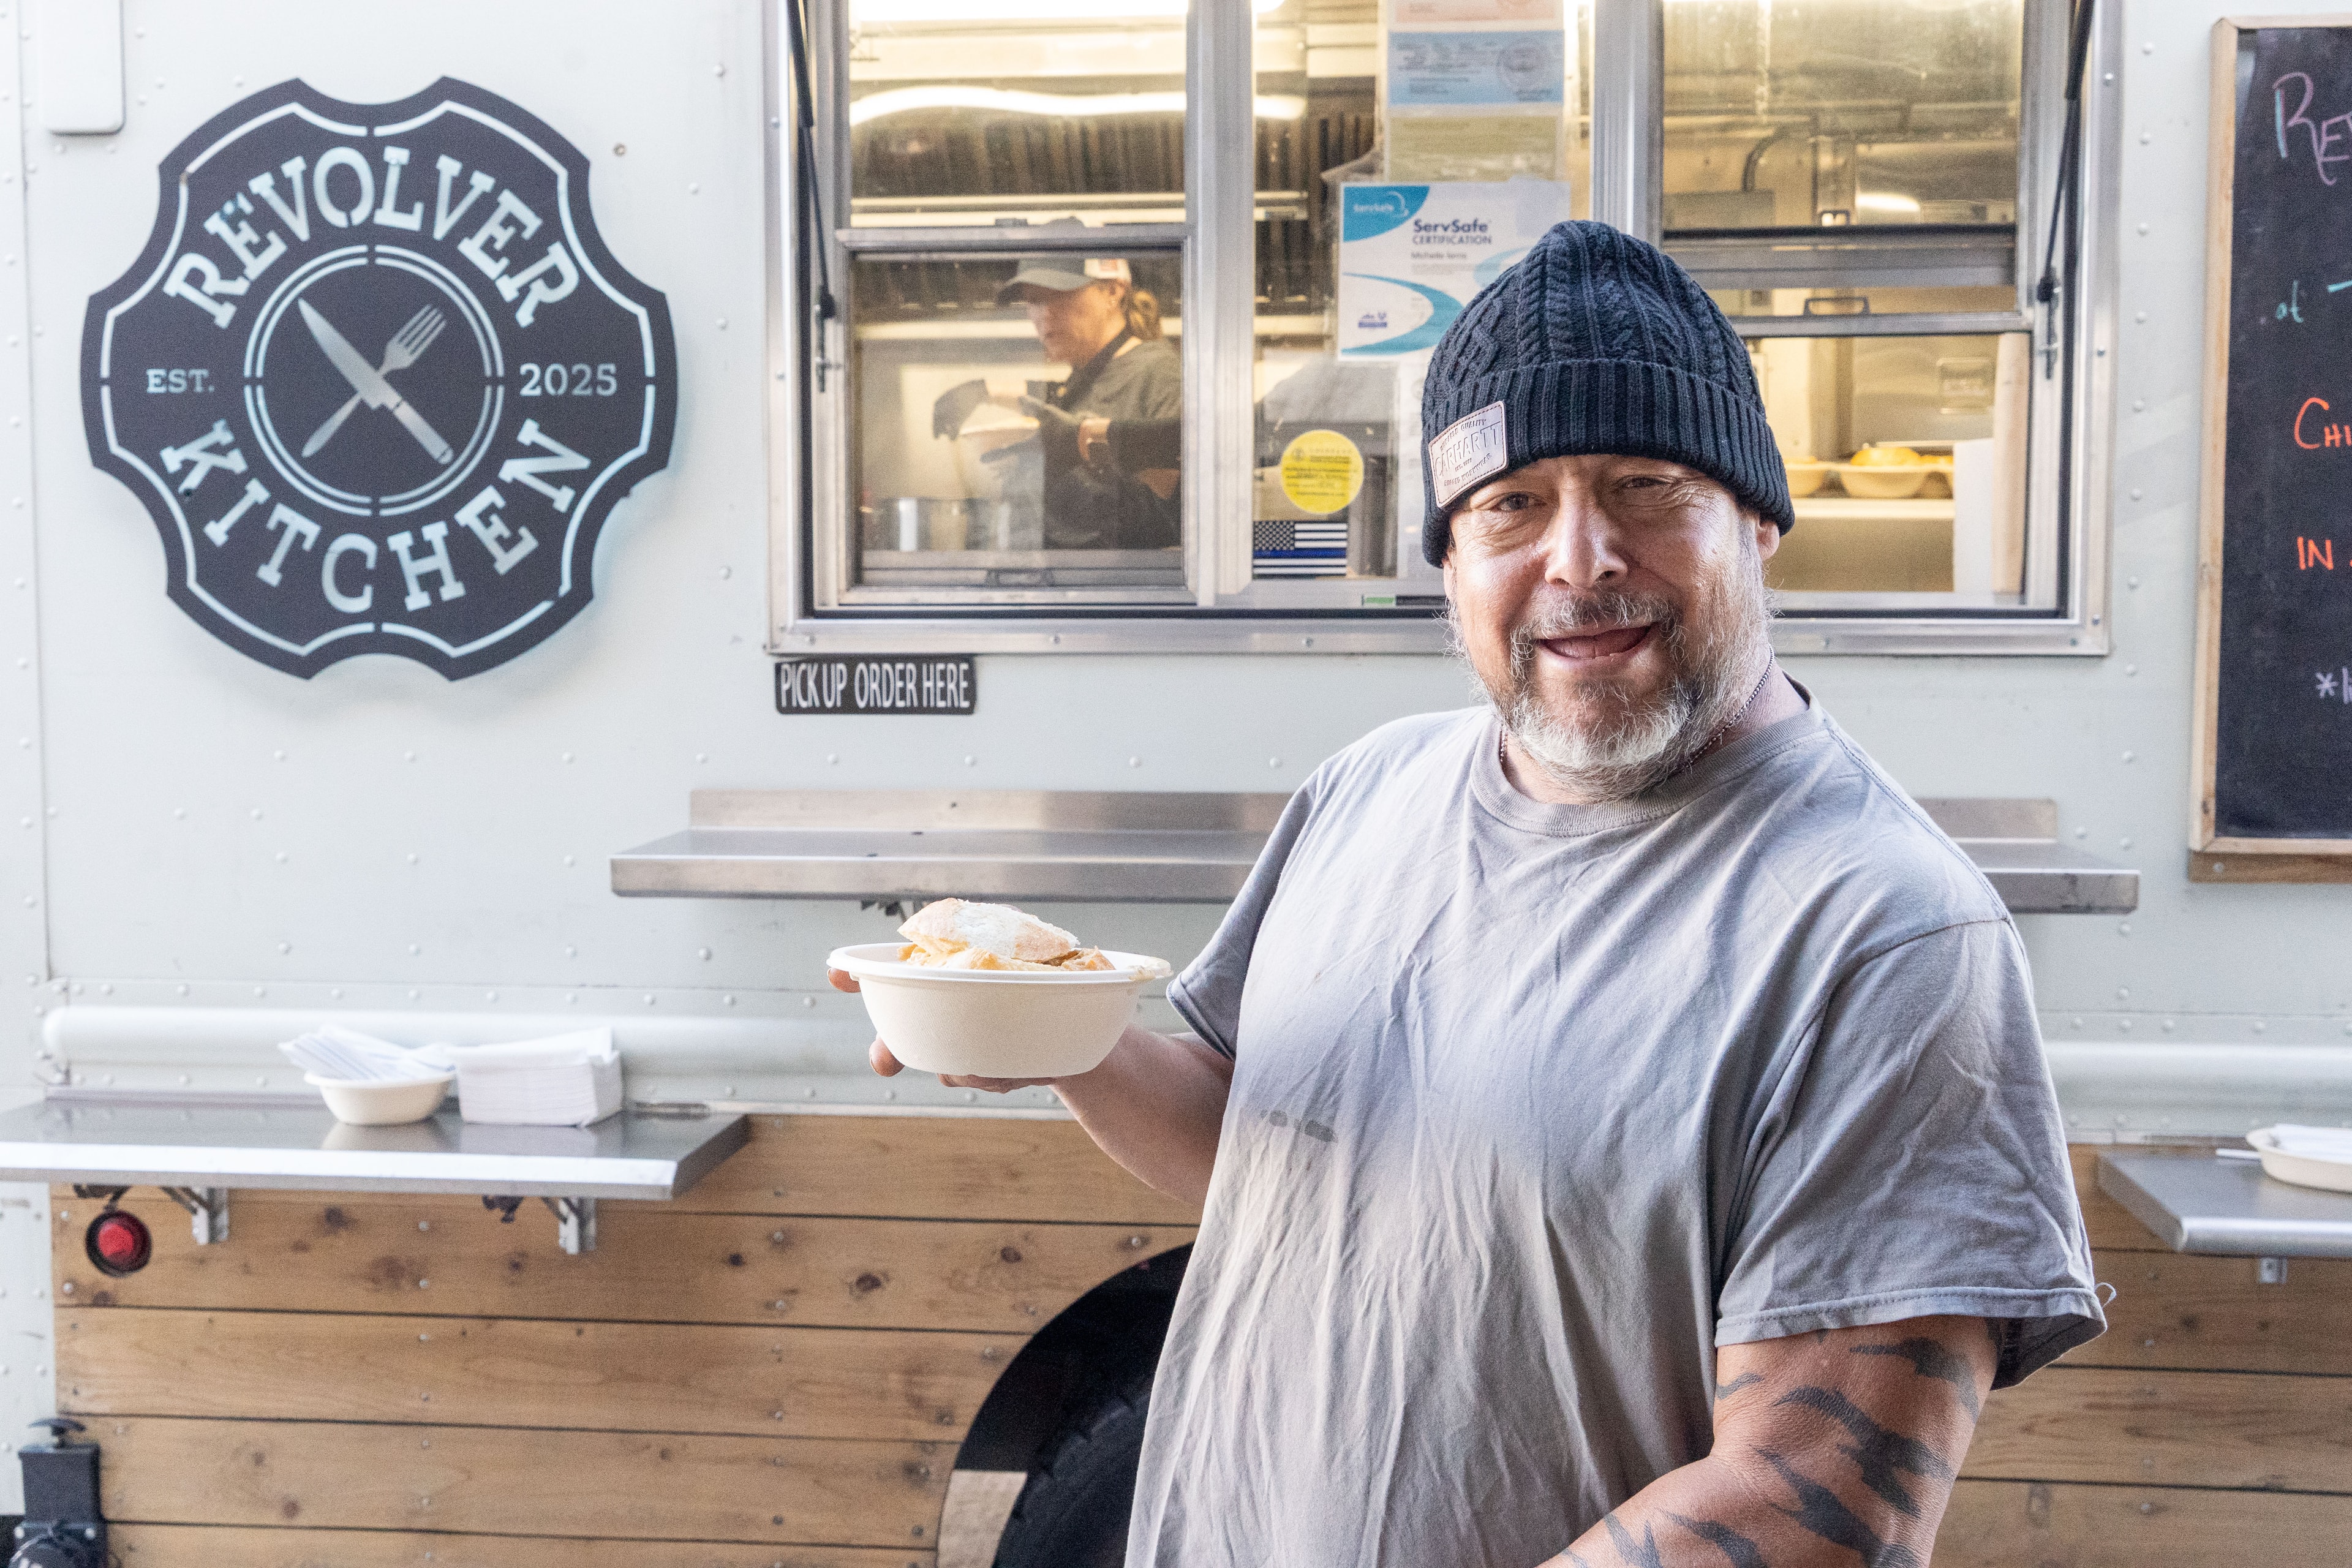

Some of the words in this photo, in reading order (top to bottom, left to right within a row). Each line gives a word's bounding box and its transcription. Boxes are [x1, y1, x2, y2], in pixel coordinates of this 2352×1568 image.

[2272, 72, 2352, 186] RE
[163, 145, 581, 330] REVOLVER
[1412, 235, 1492, 245] CERTIFICATION
[1414, 217, 1488, 233] ServSafe
[146, 368, 215, 394] EST.
[519, 363, 617, 397] 2025
[1461, 419, 1487, 431] QUALITY
[1435, 421, 1501, 479] CARHARTT
[160, 418, 592, 613] KITCHEN
[2297, 537, 2334, 570] IN
[781, 662, 820, 708] PICK
[822, 662, 848, 708] UP
[854, 662, 918, 708] ORDER
[922, 662, 970, 708] HERE
